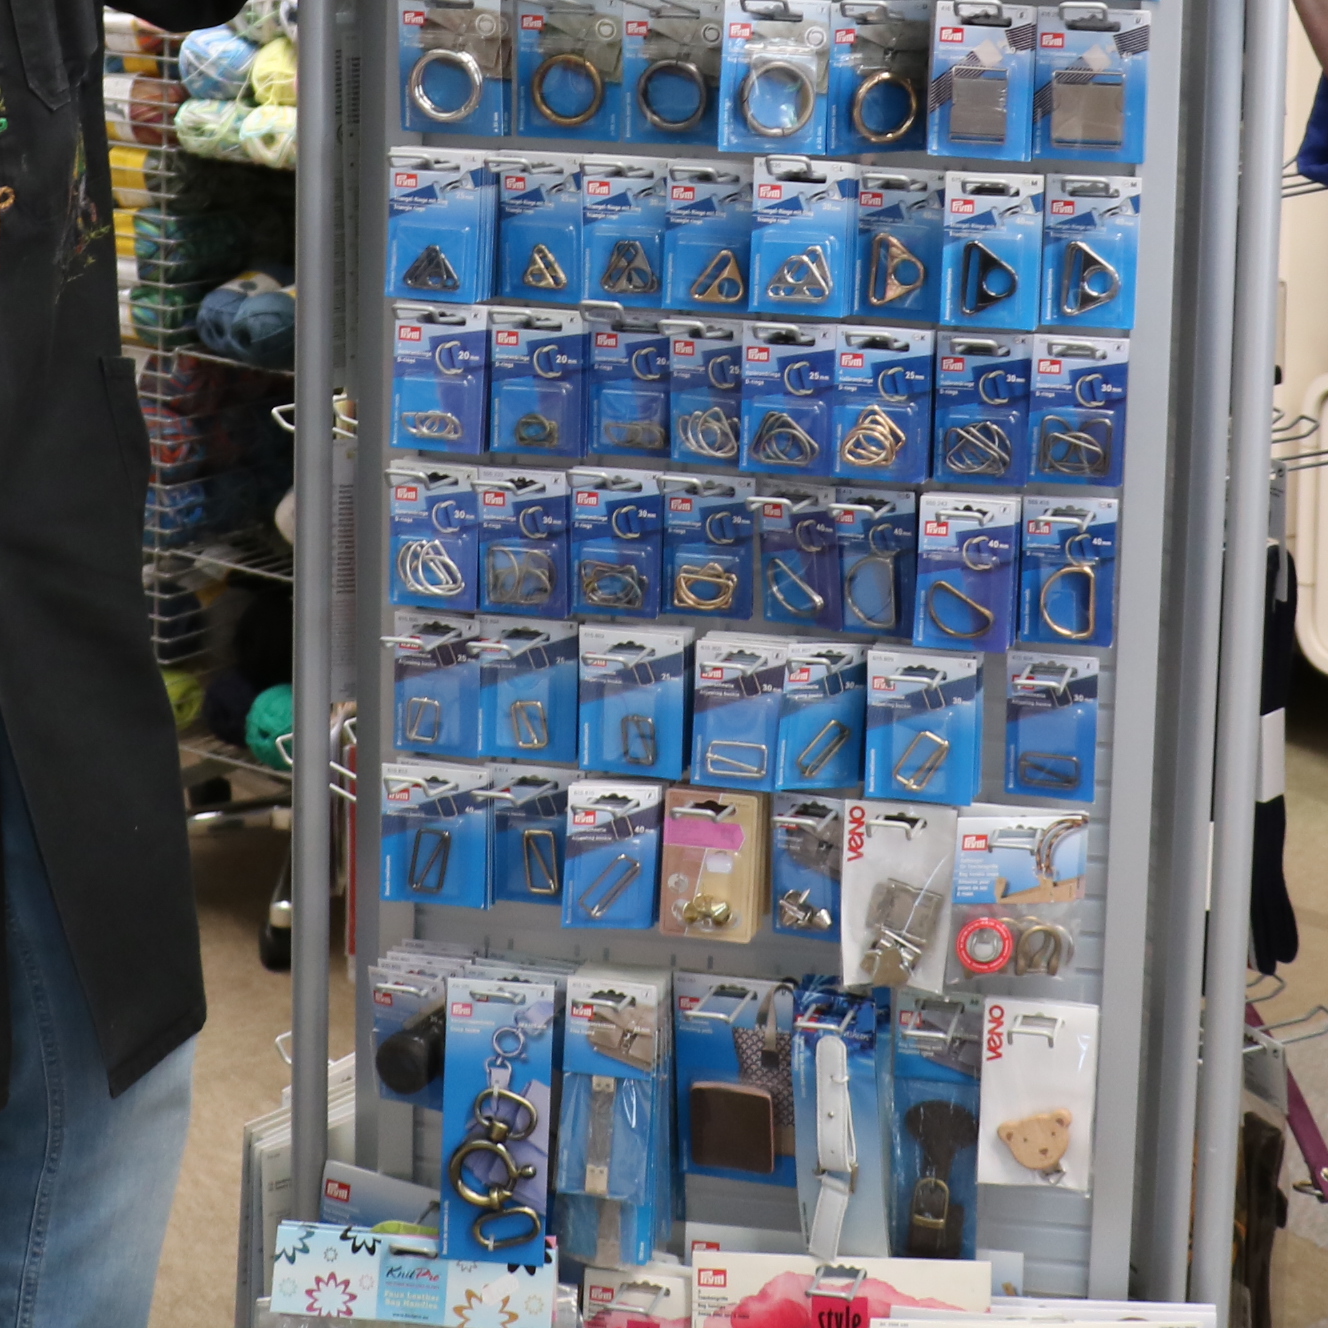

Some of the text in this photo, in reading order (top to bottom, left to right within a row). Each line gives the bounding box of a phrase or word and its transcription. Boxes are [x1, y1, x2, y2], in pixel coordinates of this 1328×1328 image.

[404, 12, 426, 24] Prym
[522, 16, 544, 30] Prym
[628, 22, 648, 36] Prym
[732, 24, 752, 38] Prym
[836, 30, 856, 42] Prym
[942, 28, 964, 42] Prym
[1042, 34, 1064, 48] Prym
[396, 174, 418, 186] Prym
[588, 182, 610, 194] Prym
[674, 186, 694, 200] Prym
[760, 184, 782, 198] Prym
[952, 200, 974, 212] Prym
[1052, 200, 1074, 214] Prym
[400, 326, 422, 340] Prym
[498, 332, 518, 344] Prym
[598, 334, 618, 346] Prym
[748, 348, 770, 360] Prym
[842, 354, 864, 366] Prym
[944, 358, 964, 370] Prym
[1040, 360, 1062, 374] Prym
[396, 486, 418, 500] Prym
[484, 492, 504, 506] Prym
[578, 492, 598, 504] Prym
[926, 522, 948, 536] Prym
[963, 835, 987, 849] Prym
[327, 1180, 350, 1201] Prym
[386, 1266, 440, 1282] KnitPro
[699, 1269, 727, 1287] Prym
[818, 1306, 862, 1328] style
